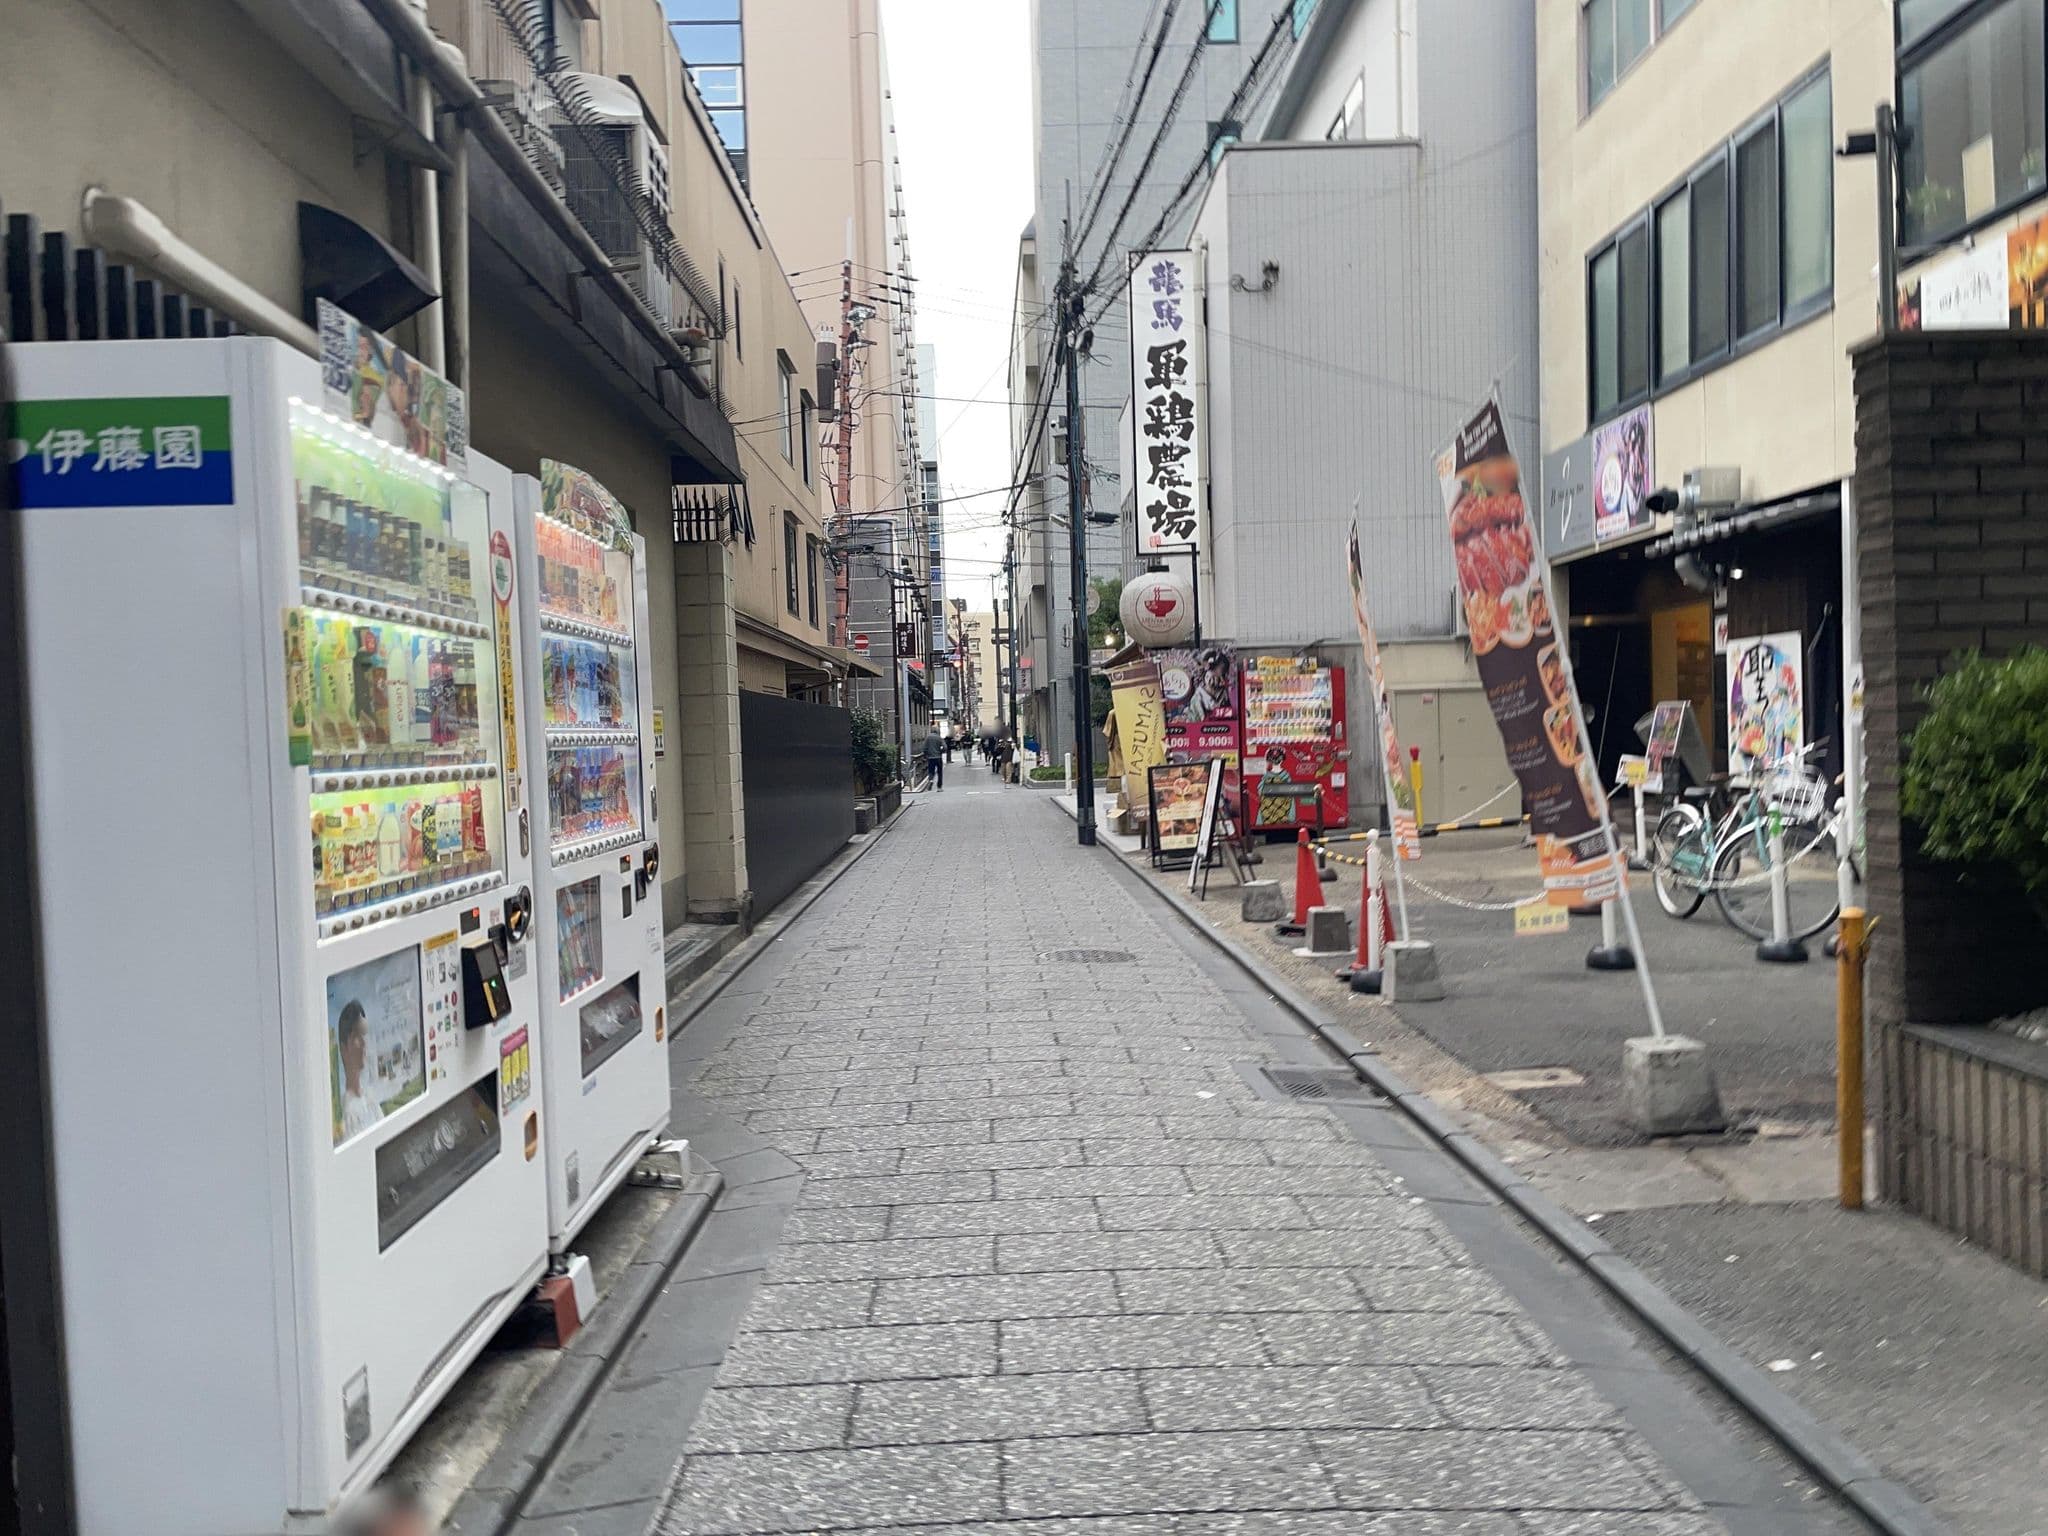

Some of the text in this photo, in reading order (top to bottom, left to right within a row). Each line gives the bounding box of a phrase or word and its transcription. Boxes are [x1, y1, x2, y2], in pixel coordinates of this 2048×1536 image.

[35, 424, 204, 475] 伊藤園
[1144, 260, 1197, 541] 龍馬 軍鶏農場
